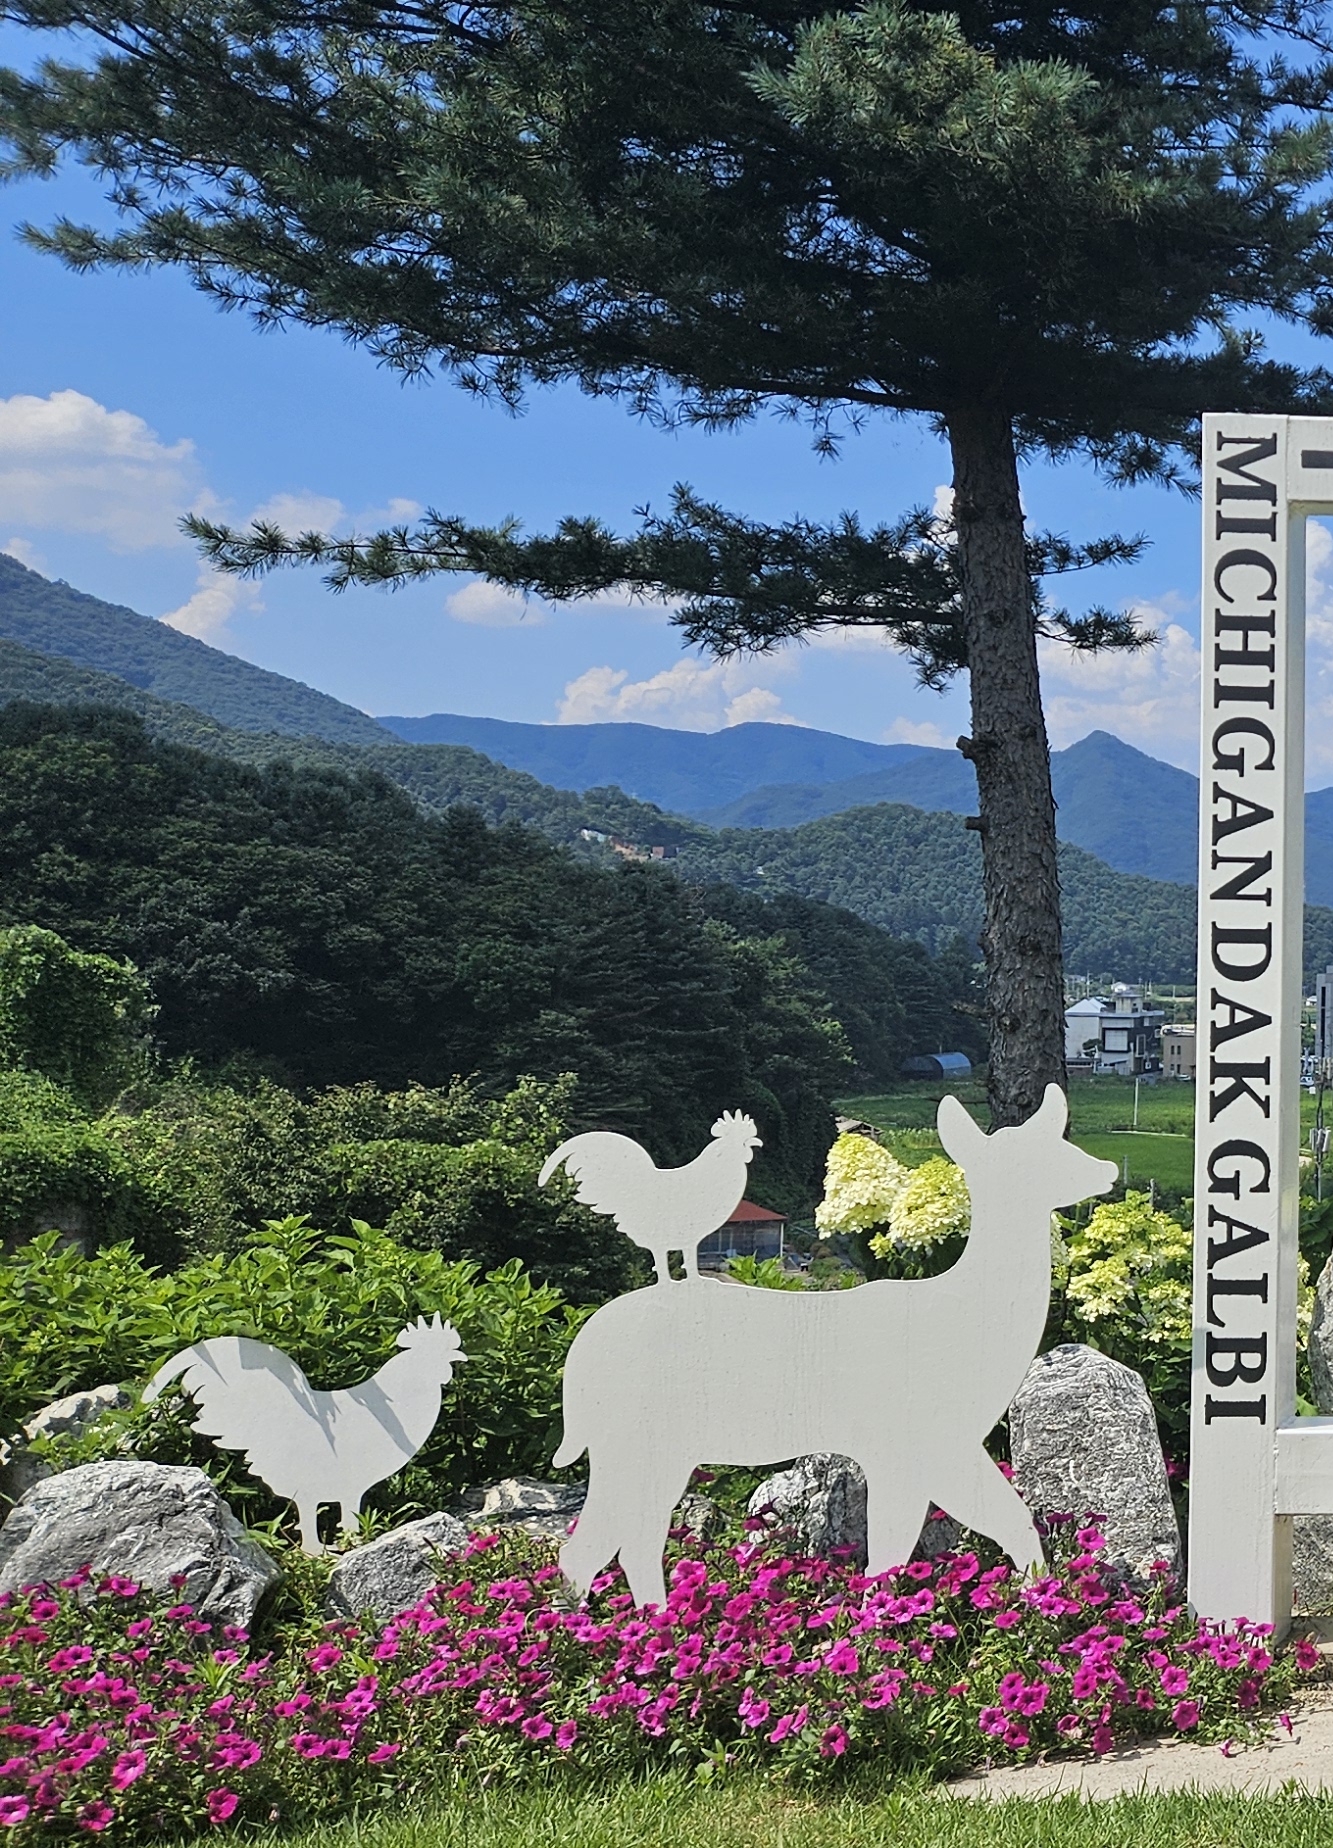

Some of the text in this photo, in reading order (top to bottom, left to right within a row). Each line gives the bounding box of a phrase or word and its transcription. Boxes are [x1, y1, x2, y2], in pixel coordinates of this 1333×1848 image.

[1205, 430, 1278, 1427] MICHIGAN DAK GALBI
